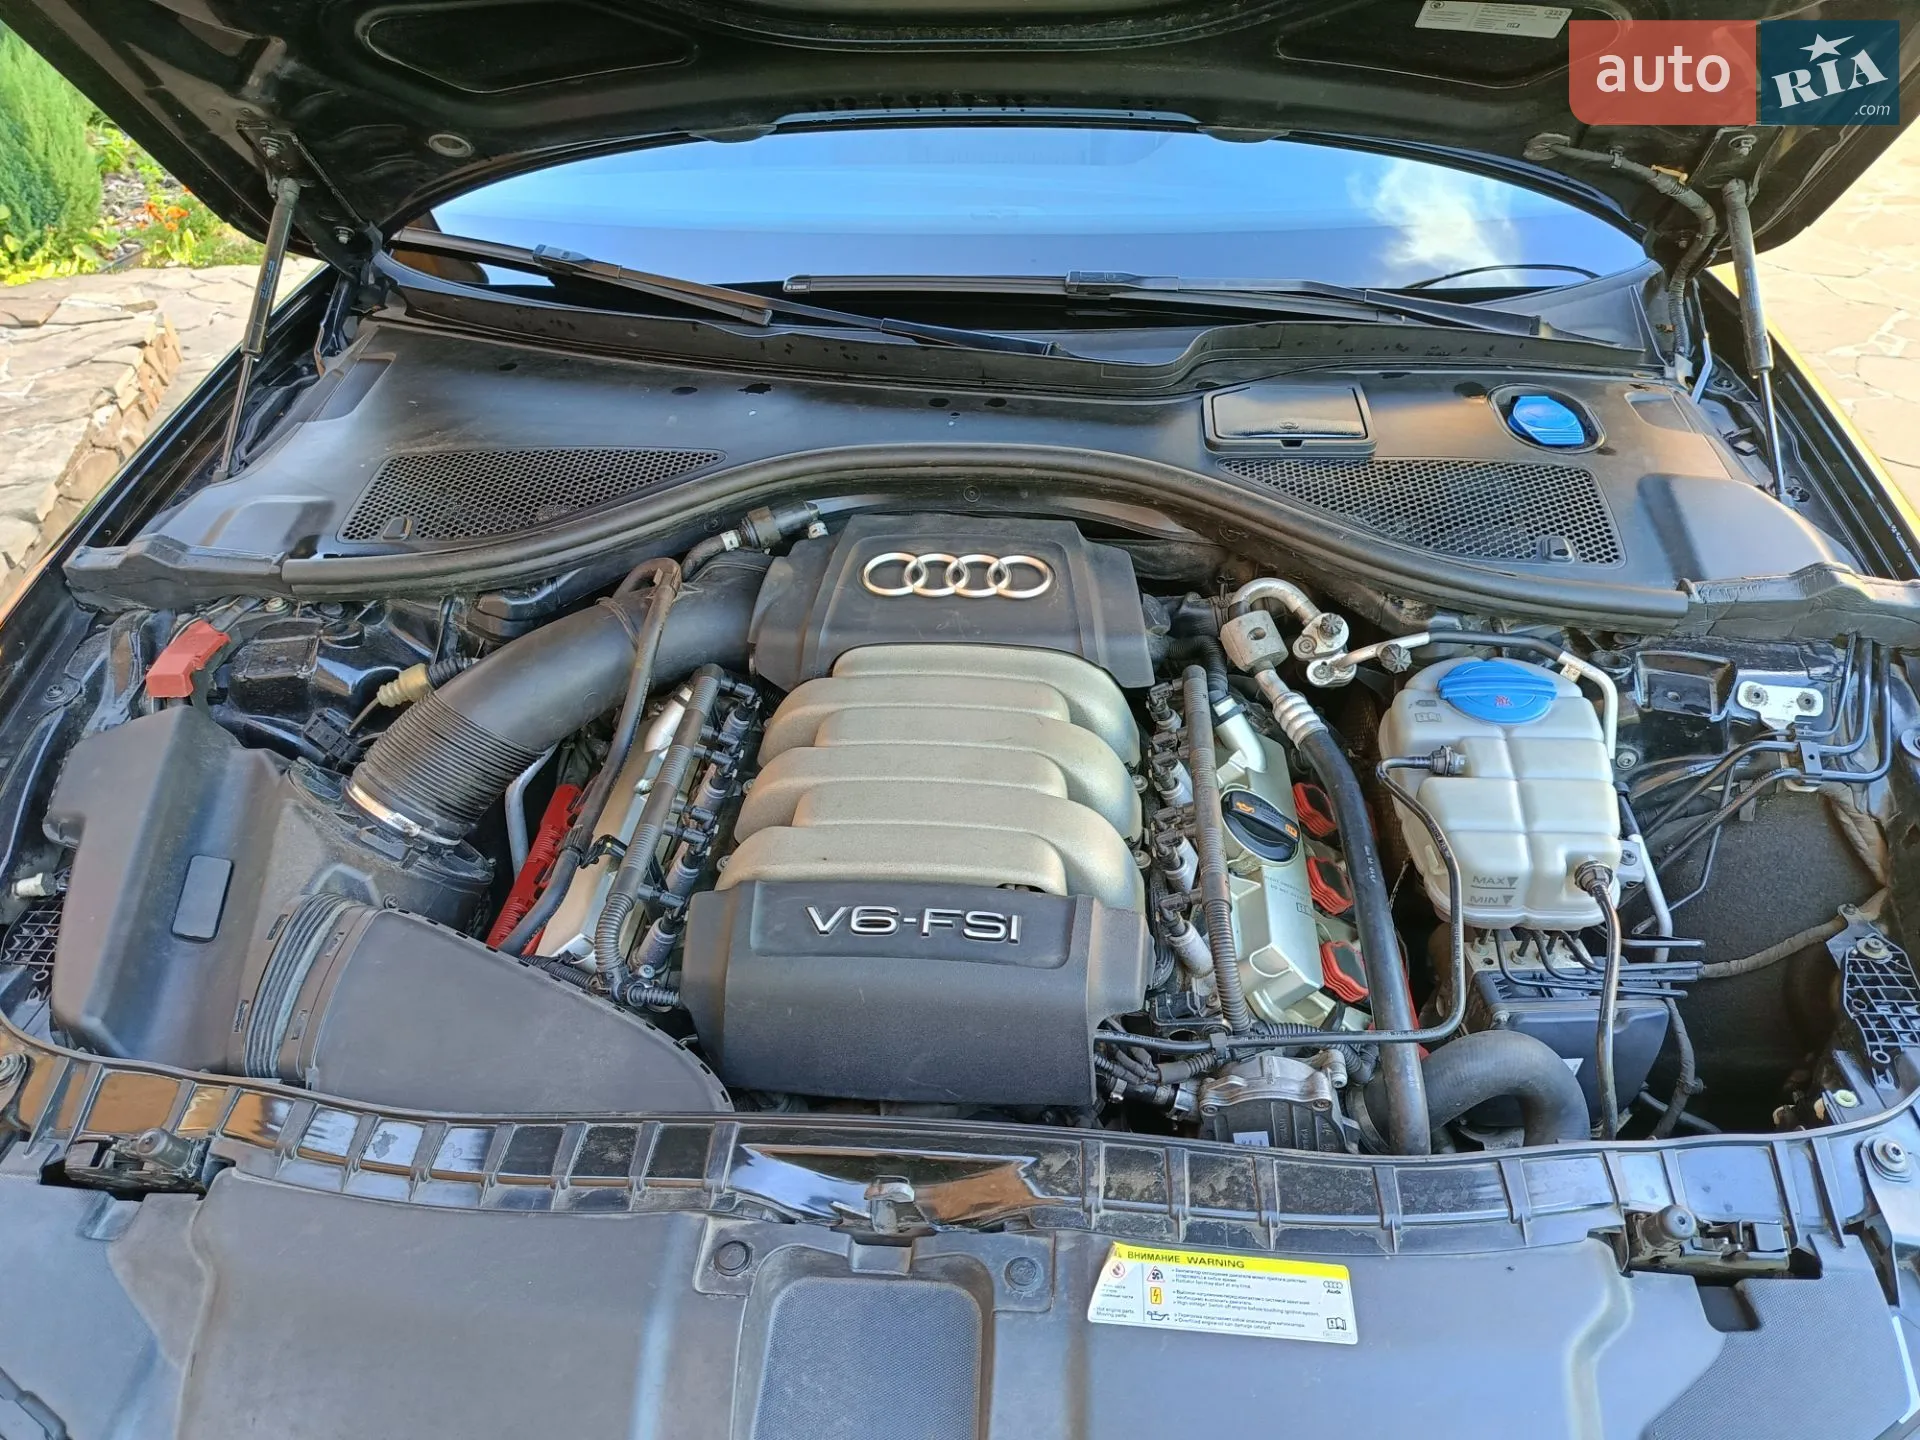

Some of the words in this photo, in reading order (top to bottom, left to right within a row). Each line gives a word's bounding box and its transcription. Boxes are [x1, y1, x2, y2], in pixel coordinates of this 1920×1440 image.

[1473, 875, 1505, 885] MAX
[1470, 895, 1499, 904] MIN
[805, 905, 1022, 944] V6-FSI
[1127, 1250, 1181, 1263] ВНИМАНИЕ
[1187, 1256, 1245, 1268] WARNING
